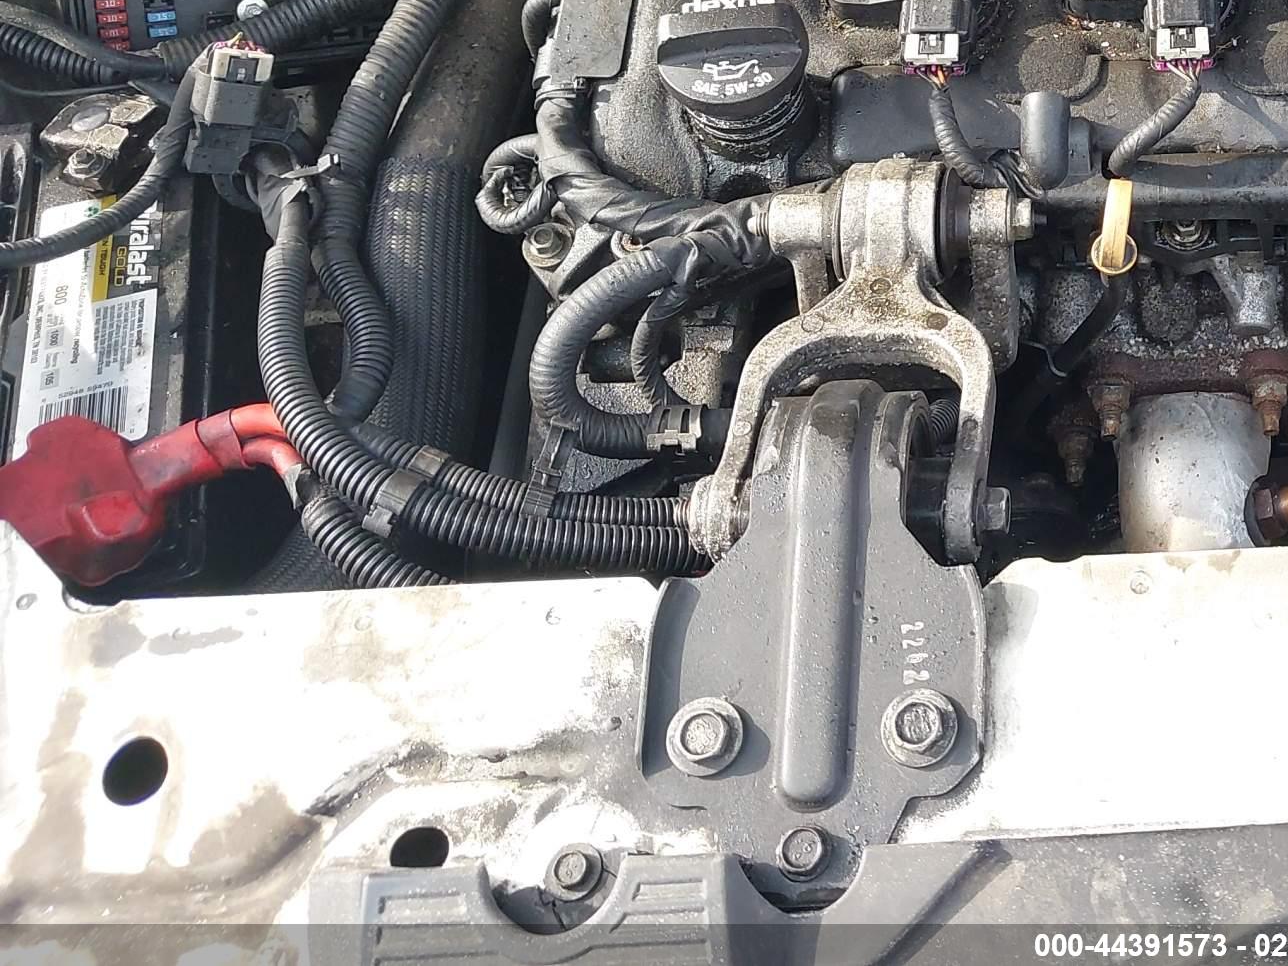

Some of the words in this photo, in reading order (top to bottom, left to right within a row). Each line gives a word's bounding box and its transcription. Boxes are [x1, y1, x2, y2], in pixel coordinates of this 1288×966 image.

[692, 80, 720, 96] SAE
[725, 72, 773, 96] 5W-30
[114, 246, 128, 286] GOLD
[54, 285, 68, 306] 800
[49, 330, 59, 347] 1000
